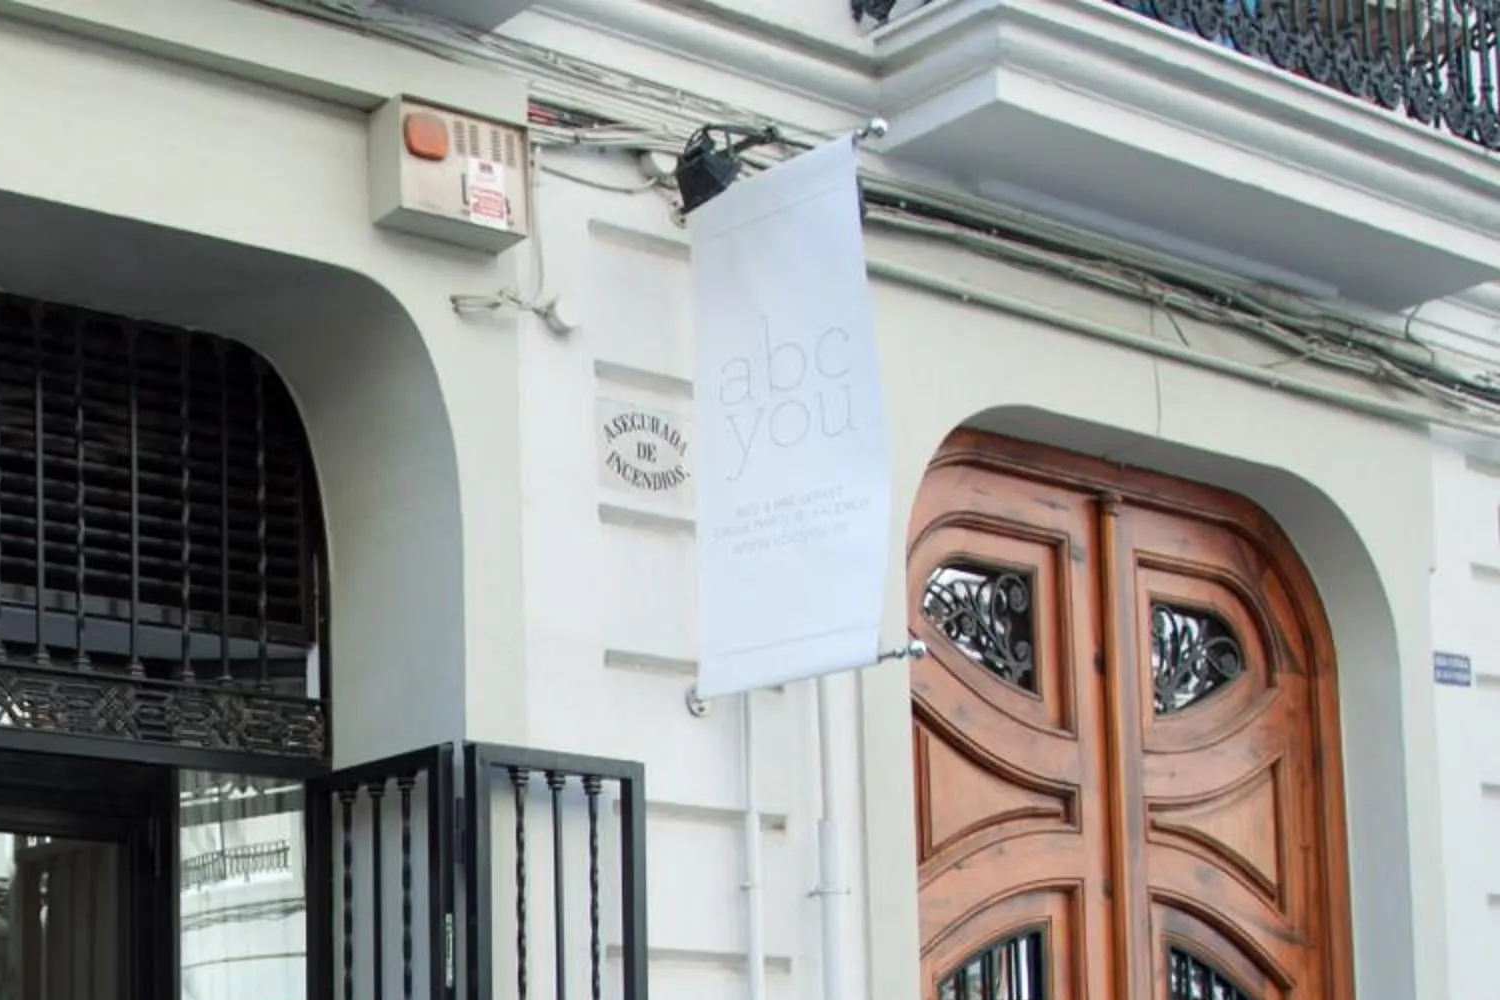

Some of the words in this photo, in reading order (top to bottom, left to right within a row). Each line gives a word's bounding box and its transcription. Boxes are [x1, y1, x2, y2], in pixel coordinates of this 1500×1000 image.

[719, 315, 851, 406] abc
[637, 441, 657, 463] DE
[725, 384, 858, 482] you
